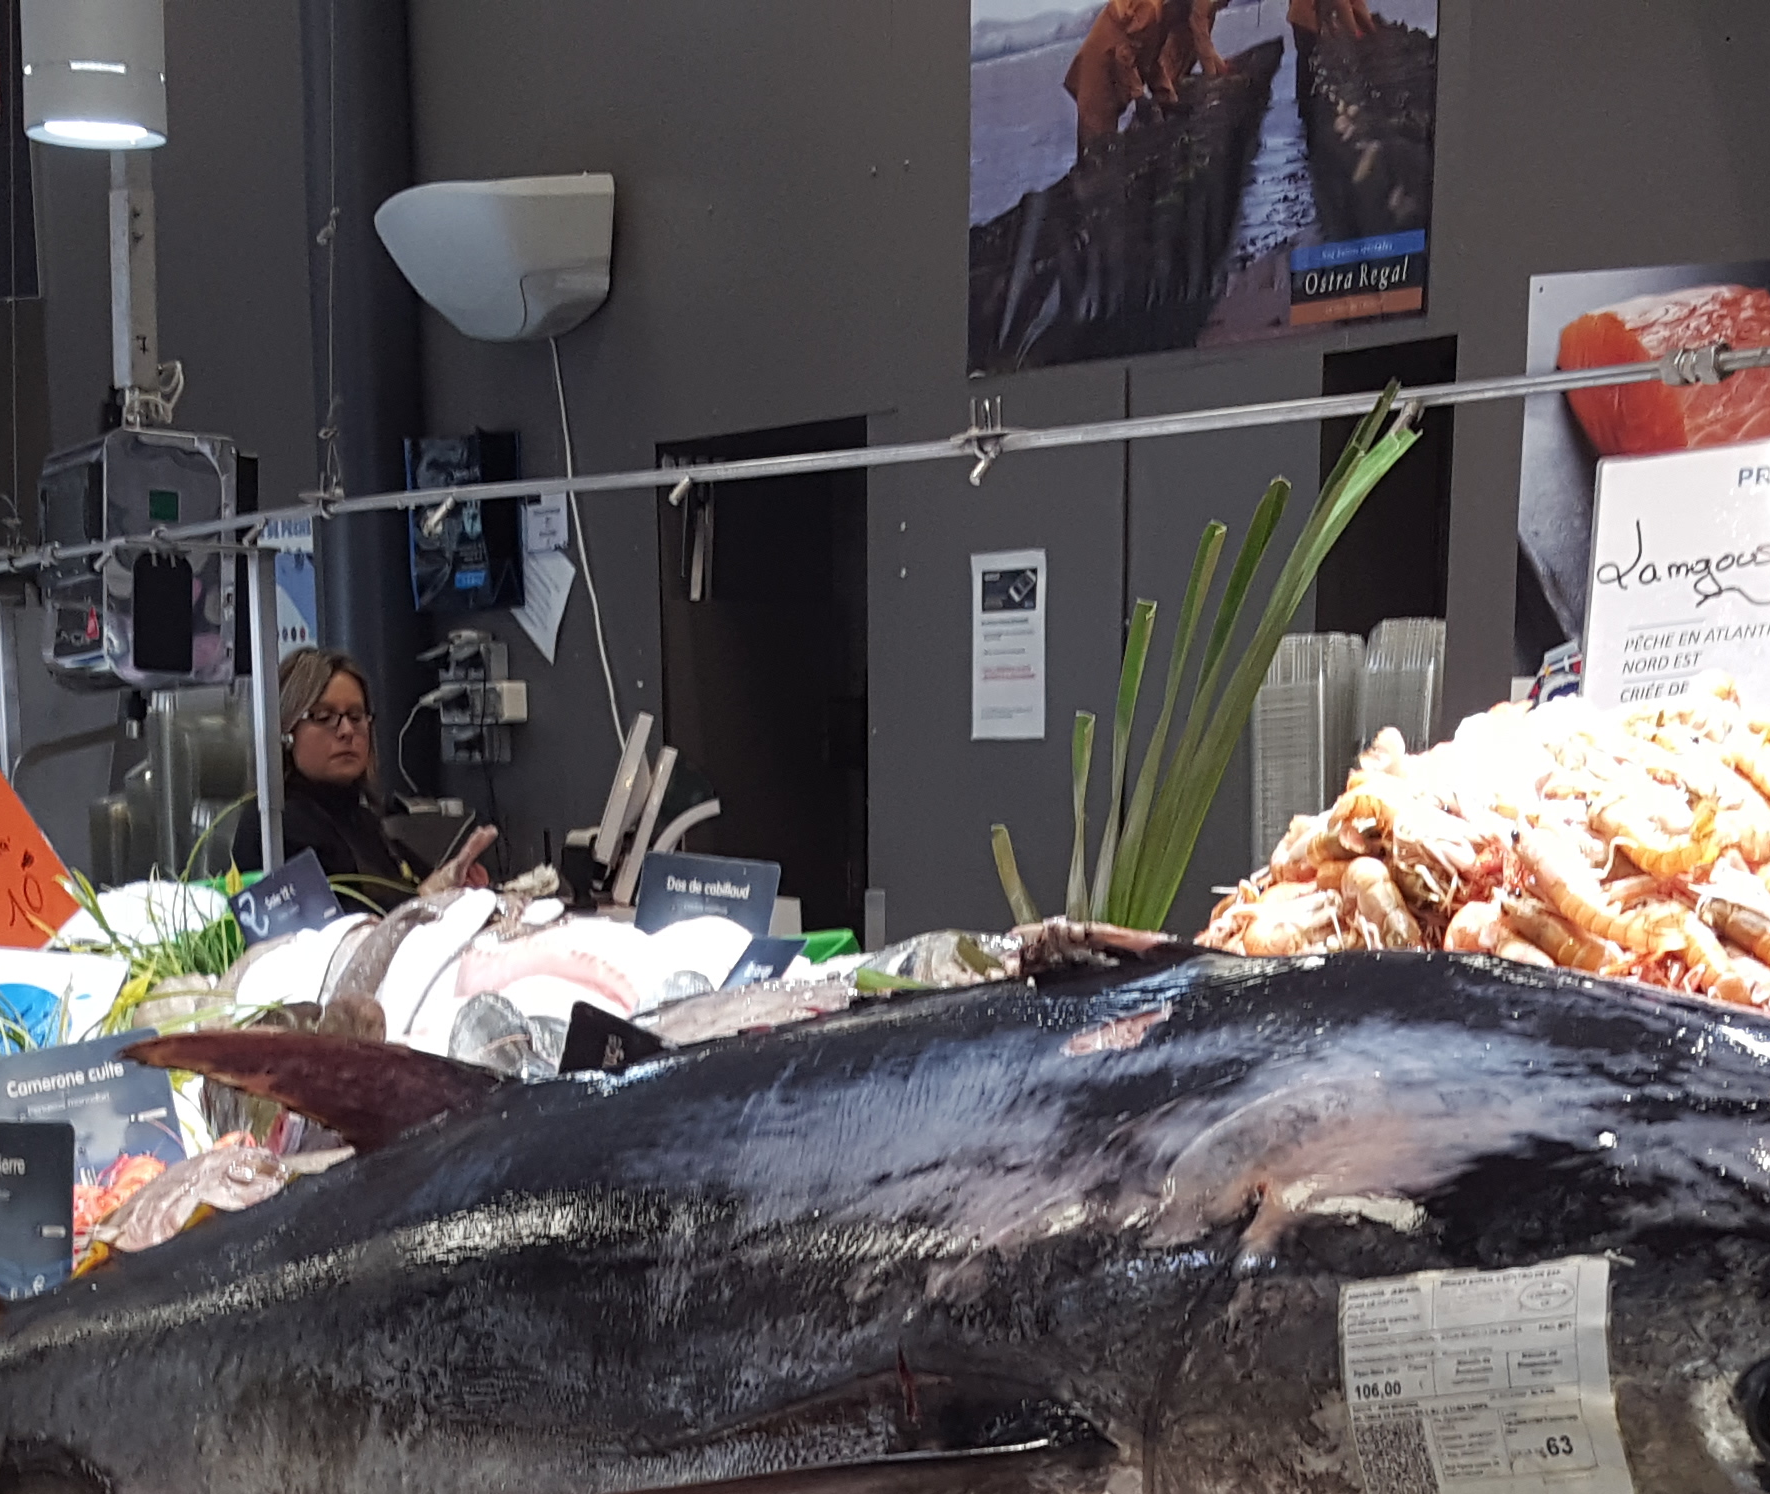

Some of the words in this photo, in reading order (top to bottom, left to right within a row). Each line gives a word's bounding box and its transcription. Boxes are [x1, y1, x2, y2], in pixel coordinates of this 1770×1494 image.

[1305, 271, 1354, 295] Ostra
[1359, 254, 1409, 291] Regal
[1623, 627, 1674, 654] PÊCHE
[1678, 625, 1702, 646] EN
[1621, 654, 1670, 676] NORD
[1673, 650, 1704, 670] EST
[1619, 679, 1663, 704] CRIÉE
[1668, 679, 1691, 696] DE
[666, 875, 688, 893] Dos
[689, 877, 703, 895] de
[704, 880, 751, 900] cabillaud
[6, 1069, 86, 1099] Camerone
[1355, 1379, 1402, 1401] 106,00
[1545, 1434, 1574, 1457] 63
